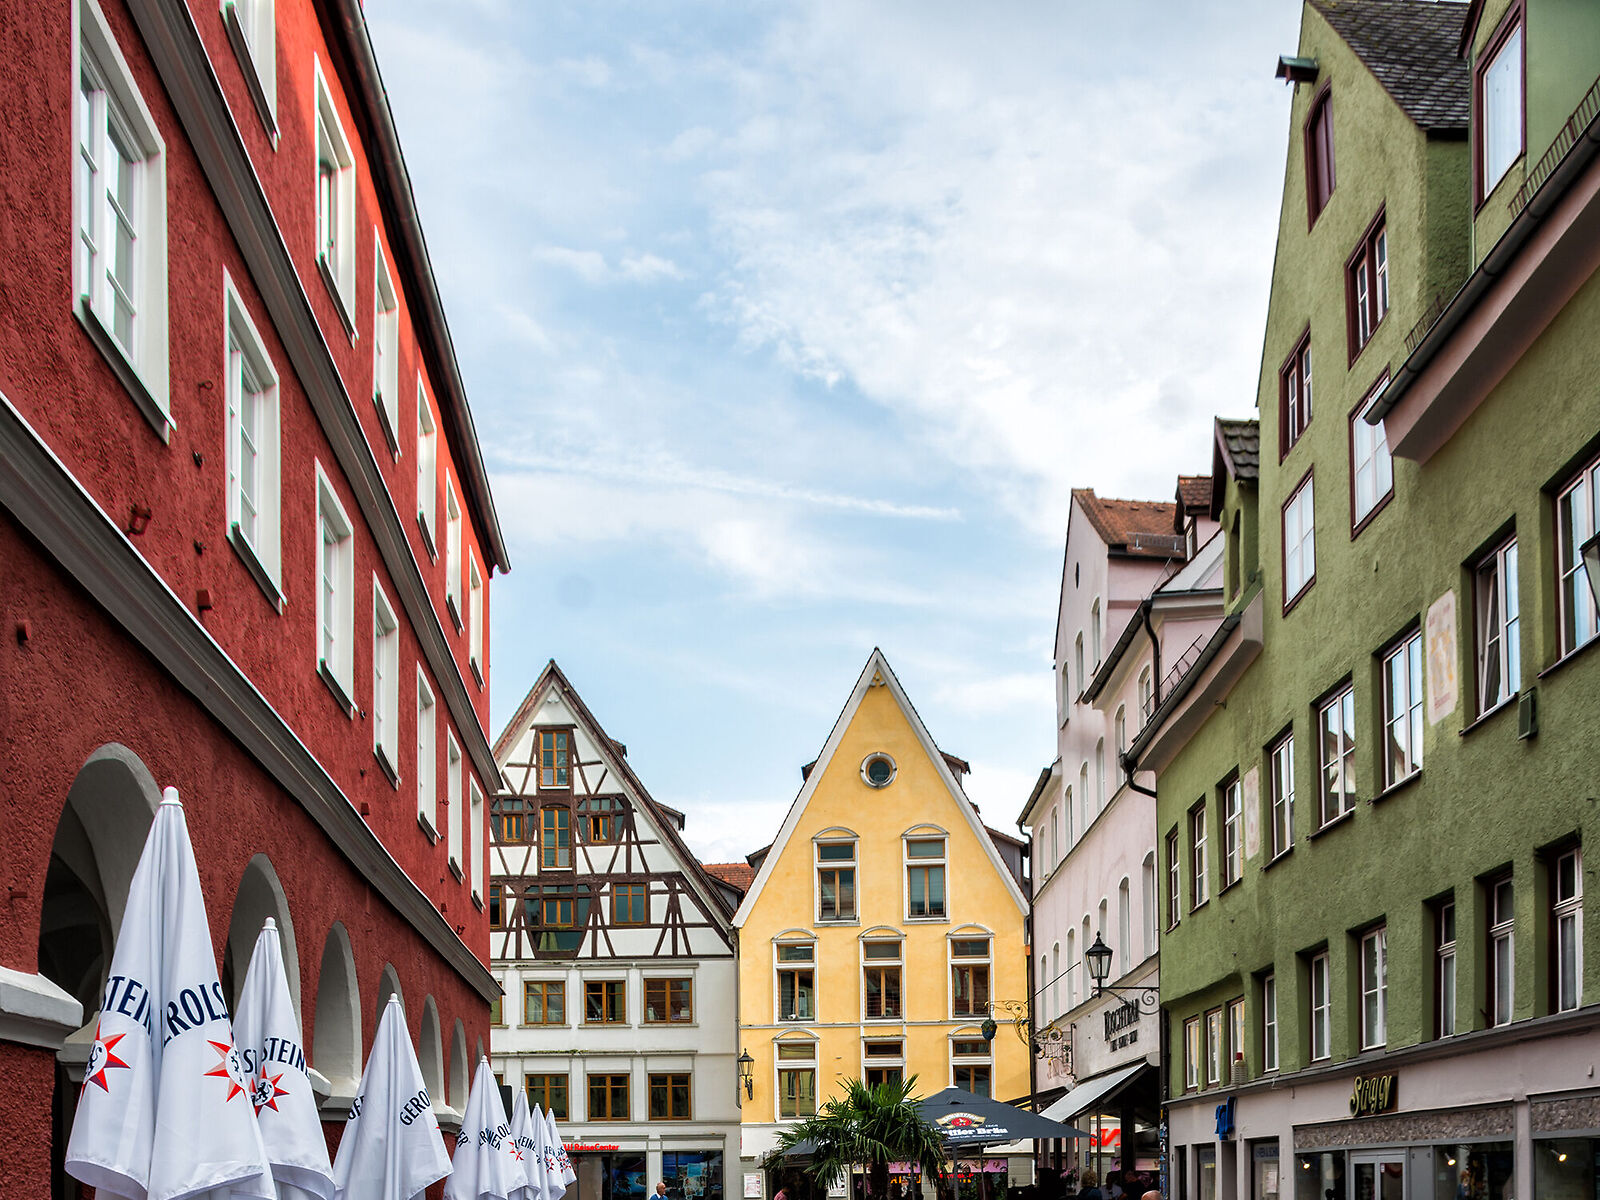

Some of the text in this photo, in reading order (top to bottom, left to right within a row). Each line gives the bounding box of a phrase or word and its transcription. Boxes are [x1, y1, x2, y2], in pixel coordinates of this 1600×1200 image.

[163, 981, 229, 1047] ROLS
[262, 1037, 309, 1079] TEIN
[400, 1088, 431, 1126] GERO
[574, 1143, 620, 1152] ReiseCenter
